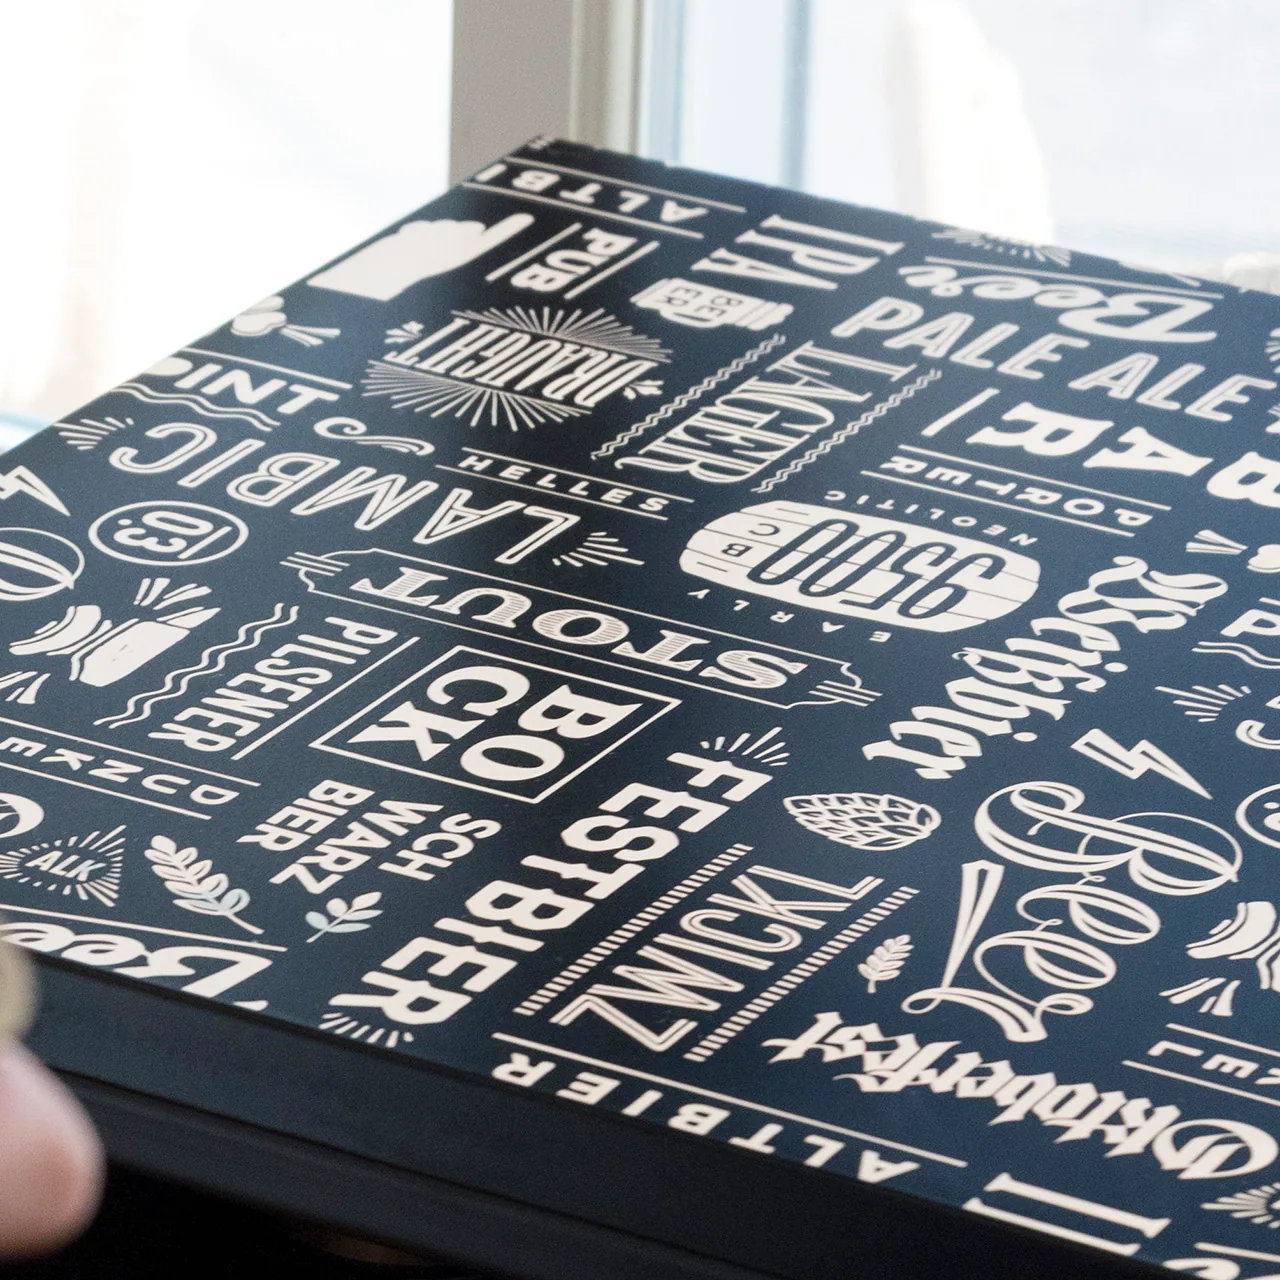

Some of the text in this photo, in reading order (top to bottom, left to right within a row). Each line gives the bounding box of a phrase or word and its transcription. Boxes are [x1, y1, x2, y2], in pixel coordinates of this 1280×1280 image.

[512, 228, 636, 294] PUB
[656, 284, 703, 306] ER
[691, 214, 905, 290] IPA
[693, 294, 743, 318] BE
[898, 263, 1218, 343] Beer
[384, 318, 657, 409] DRAUGHT
[831, 297, 1278, 422] PALE ALE
[614, 341, 919, 484] LAGER
[967, 402, 1280, 508] BAR
[110, 422, 580, 566] LAMBIC
[458, 454, 671, 512] HELLES
[825, 490, 1039, 547] NEOLITIC
[880, 454, 1154, 526] PORTER
[687, 588, 892, 644] EARLY
[746, 517, 1007, 621] 9500
[350, 565, 808, 690] STOUT
[148, 615, 399, 754] PILSENER
[347, 666, 531, 763] CK
[460, 685, 644, 782] BO
[236, 778, 375, 852] BIER
[269, 799, 444, 895] WARZ
[378, 812, 502, 881] SCH
[24, 850, 106, 882] ALK
[903, 781, 1244, 1044] Beer
[549, 865, 885, 1053] ZWICKL
[491, 1053, 921, 1185] ALTBIER
[762, 1010, 1280, 1181] Oktoberfest
